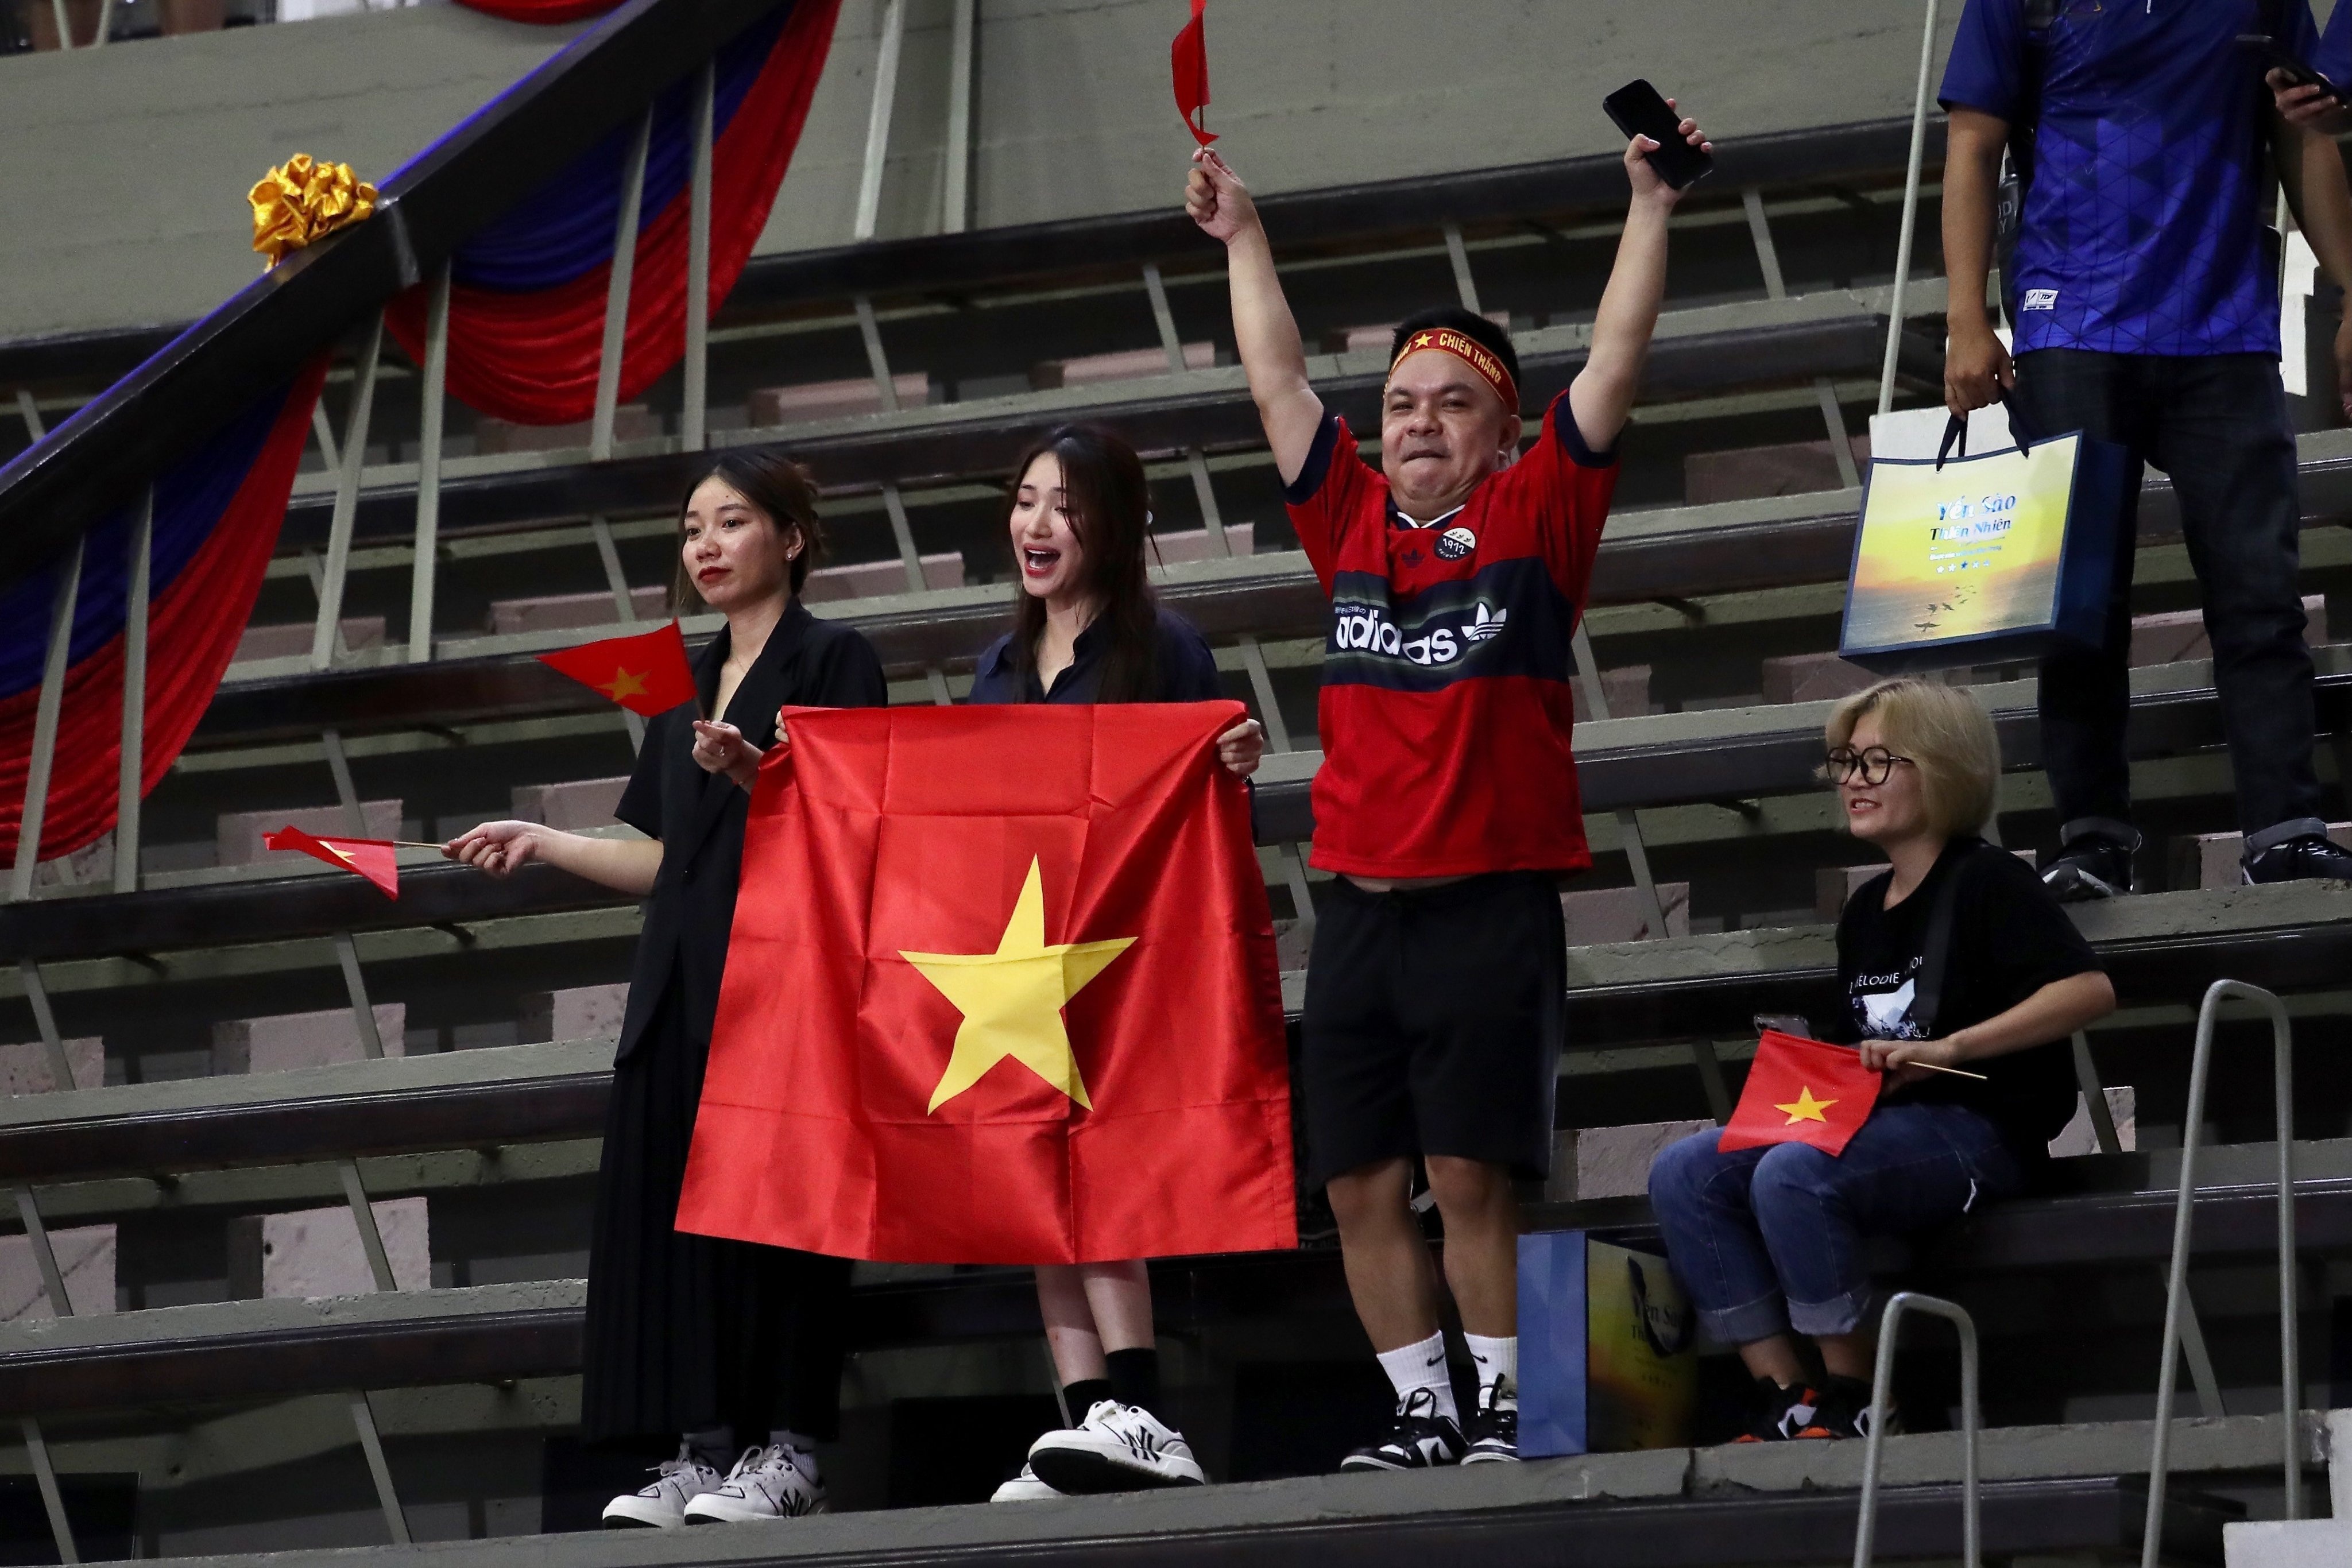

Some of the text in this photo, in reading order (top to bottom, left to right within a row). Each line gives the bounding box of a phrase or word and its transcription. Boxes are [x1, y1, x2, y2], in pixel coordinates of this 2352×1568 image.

[1936, 495, 1975, 521] Yến
[1974, 518, 2011, 535] Nhiên
[1442, 538, 1465, 555] 1972
[1336, 609, 1459, 665] adidas
